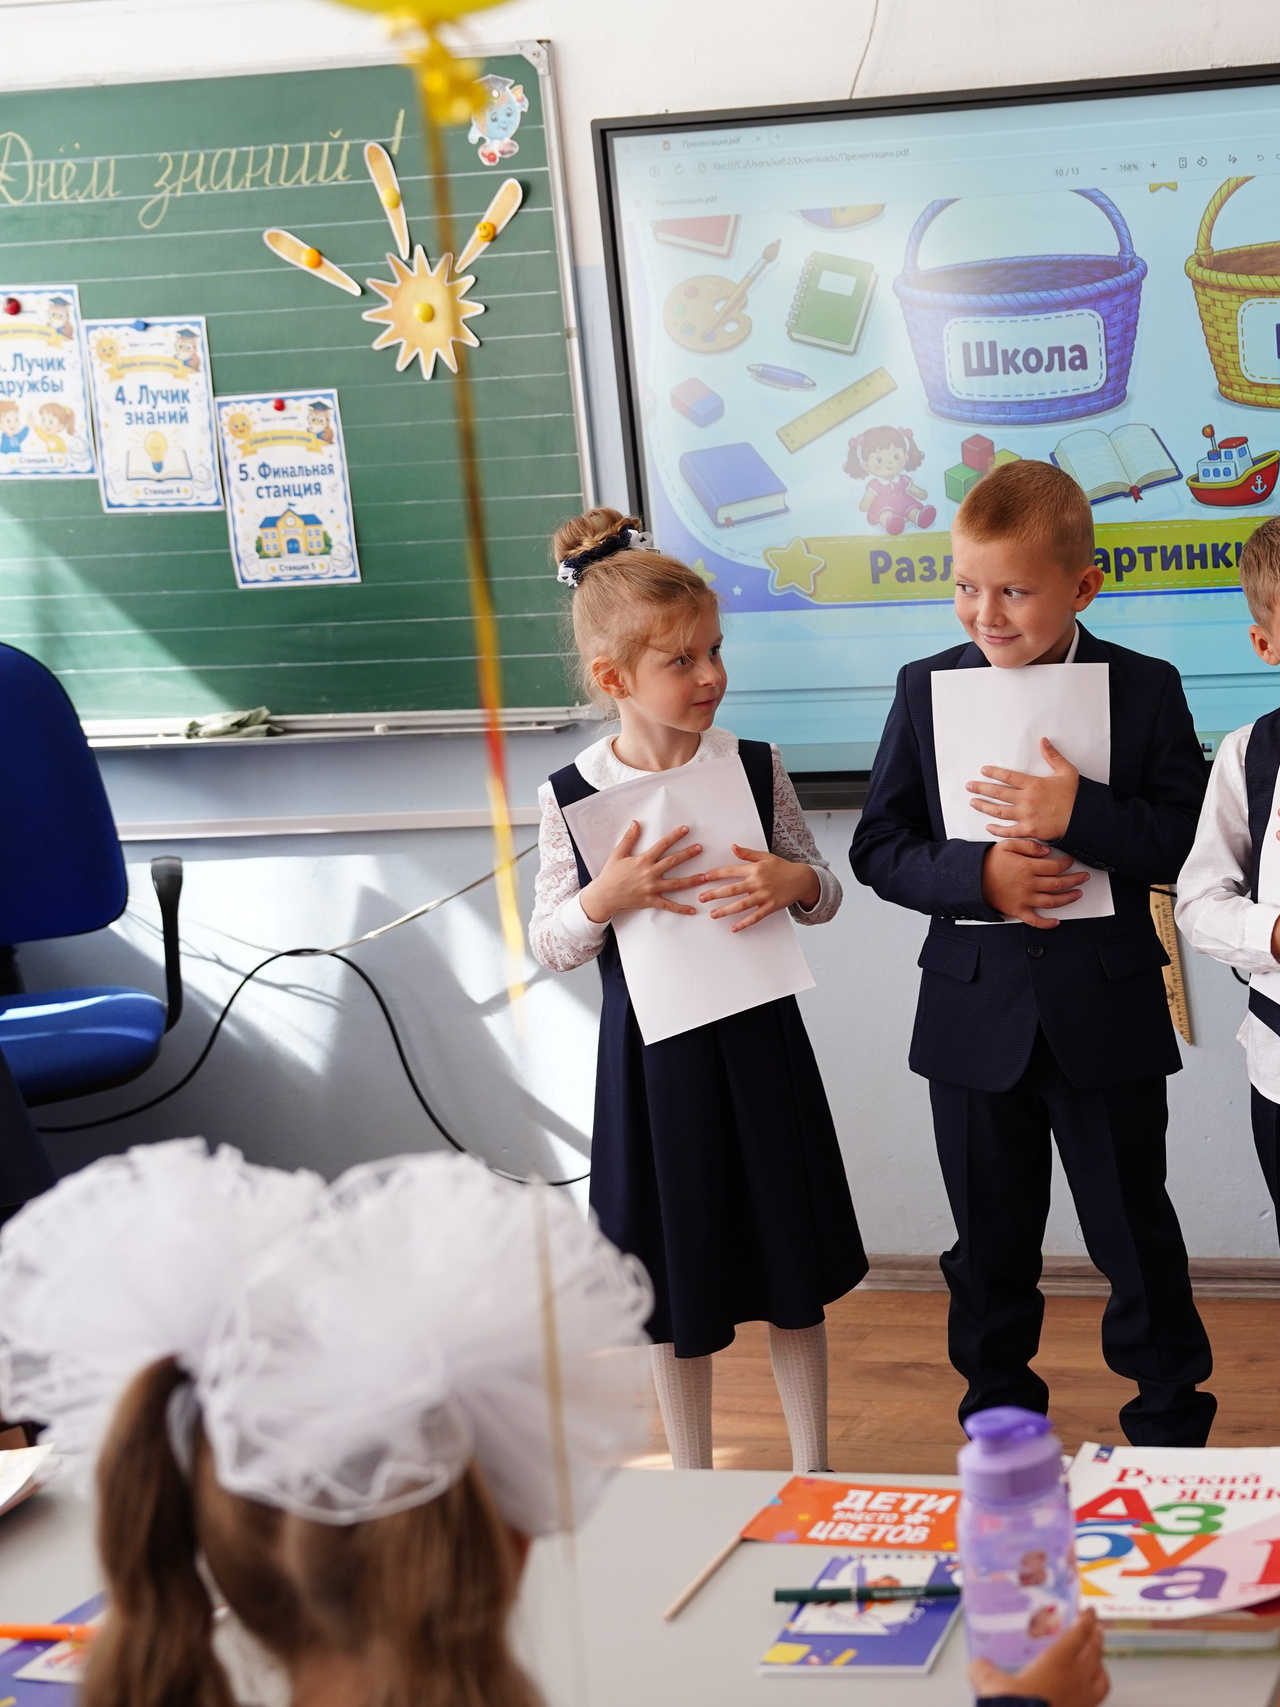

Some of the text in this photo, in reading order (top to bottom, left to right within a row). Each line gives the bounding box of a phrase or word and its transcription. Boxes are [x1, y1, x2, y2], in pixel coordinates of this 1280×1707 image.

[682, 136, 741, 149] Презентация.pdf
[1071, 167, 1080, 176] 13
[1119, 163, 1139, 172] 168%
[12, 352, 66, 376] Лучик
[962, 340, 1088, 378] Школа
[115, 384, 190, 410] 4. Лучик
[124, 408, 189, 426] знаний
[238, 461, 334, 482] 5. Финальная
[256, 482, 322, 499] станция
[870, 541, 1243, 584] Разл артинк
[1115, 1467, 1264, 1488] Русский
[832, 1489, 957, 1514] ДЕТИ
[806, 1520, 931, 1544] ЦВЕТОВ
